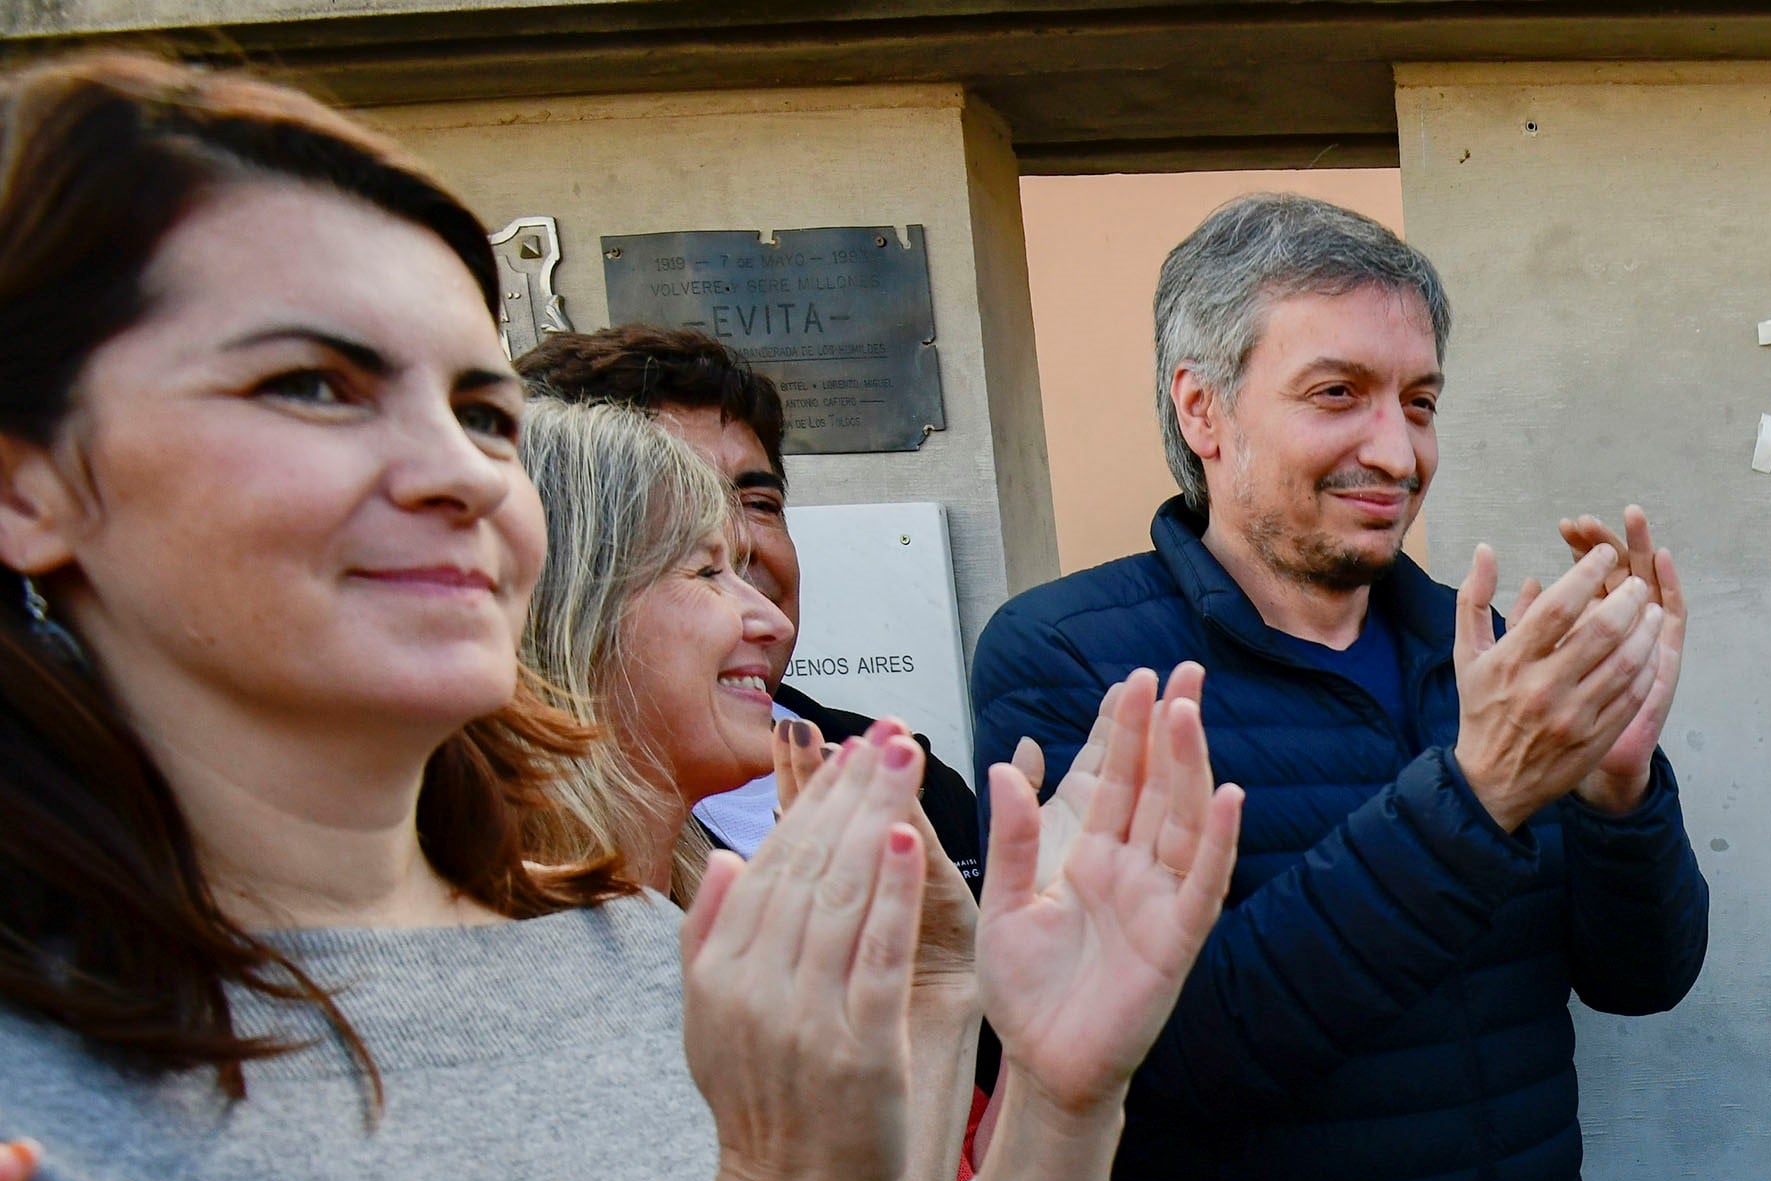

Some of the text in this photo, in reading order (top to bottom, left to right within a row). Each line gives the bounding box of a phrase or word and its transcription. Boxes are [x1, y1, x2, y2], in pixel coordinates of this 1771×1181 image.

[655, 256, 686, 272] 1919
[760, 251, 805, 270] MAYO
[650, 279, 723, 298] VOLVERE
[746, 278, 791, 295] SERE
[857, 654, 914, 675] AIRES
